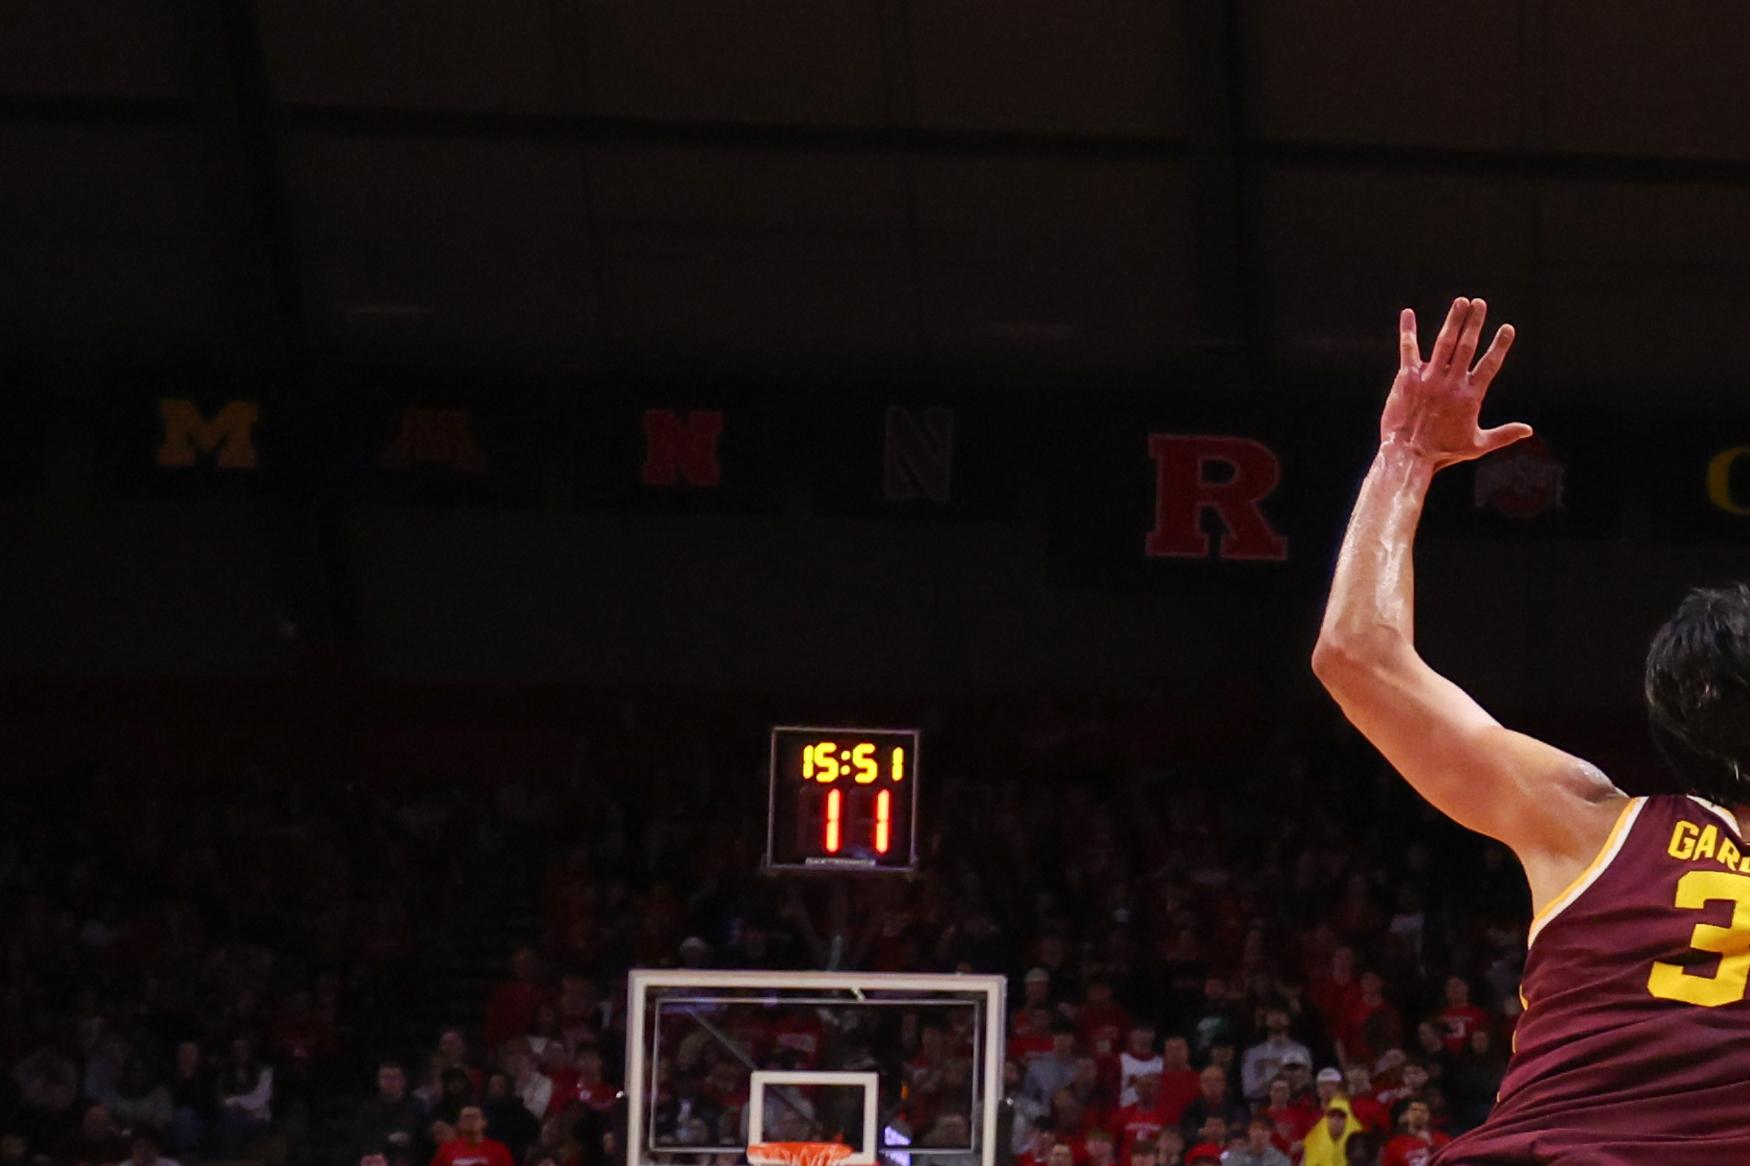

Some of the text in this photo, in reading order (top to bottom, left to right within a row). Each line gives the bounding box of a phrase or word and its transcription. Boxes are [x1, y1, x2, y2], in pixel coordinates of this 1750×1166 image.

[156, 398, 259, 470] M
[641, 408, 726, 488] N
[884, 404, 953, 502] N
[1144, 433, 1289, 561] R
[802, 742, 904, 784] 15:51
[826, 788, 891, 855] 11
